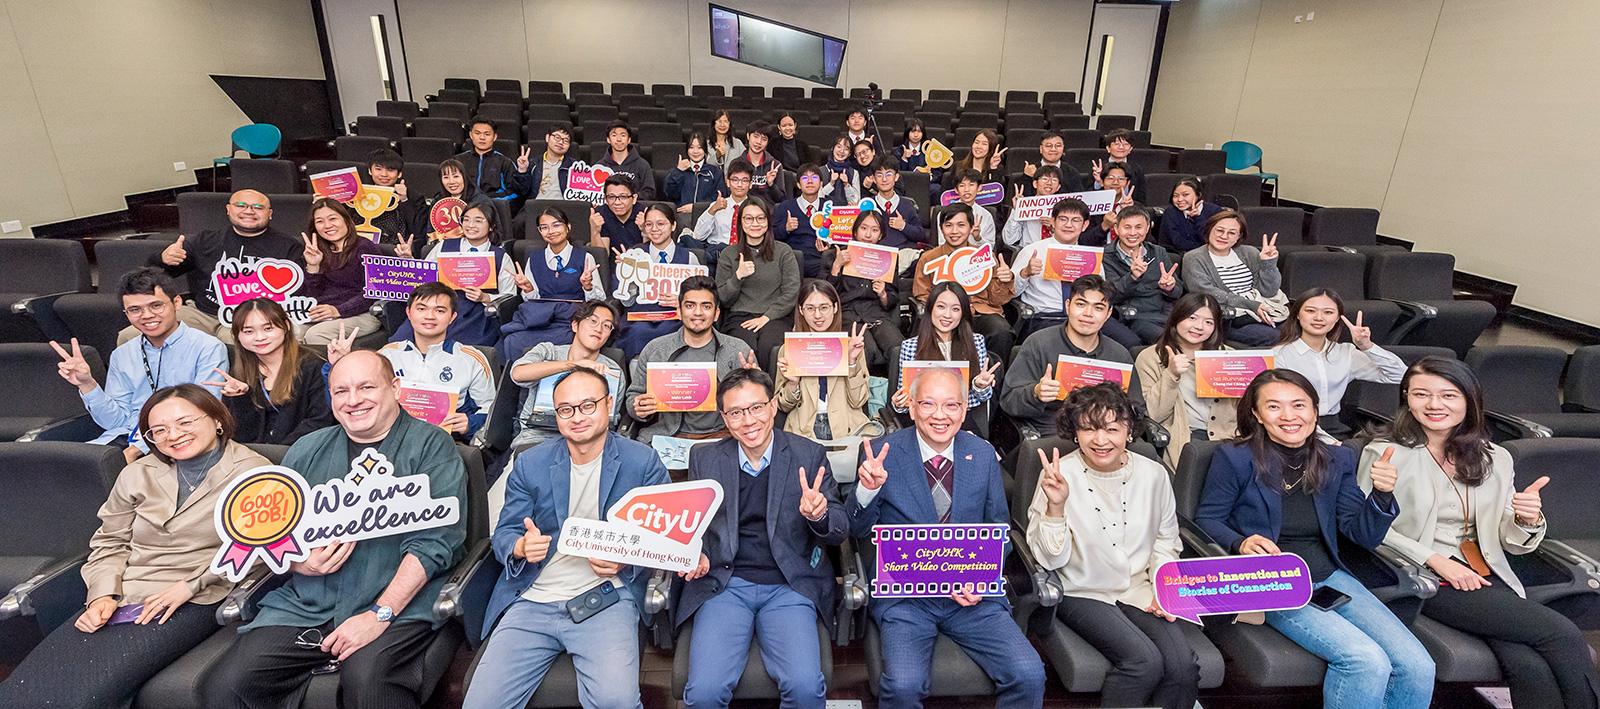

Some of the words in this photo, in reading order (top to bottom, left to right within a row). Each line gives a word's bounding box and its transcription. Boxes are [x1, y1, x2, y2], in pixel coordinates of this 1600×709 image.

[573, 163, 591, 173] We
[572, 175, 590, 184] Love
[566, 189, 606, 204] CityUH
[440, 205, 463, 226] 30
[1019, 208, 1043, 218] INTO
[971, 251, 991, 264] CityU
[221, 261, 254, 280] We
[387, 270, 416, 279] CityUHK
[653, 265, 691, 278] Cheers
[964, 275, 982, 284] YEARS
[223, 282, 262, 297] Love
[646, 278, 672, 300] 30
[240, 491, 285, 513] GOOD
[314, 485, 361, 515] We
[369, 482, 422, 503] are
[242, 499, 289, 529] JOB!
[627, 502, 702, 534] CityU
[303, 504, 451, 543] excellence
[569, 525, 641, 545] 香港城市大學
[565, 538, 584, 551] City
[585, 541, 630, 557] University
[630, 548, 641, 557] of
[642, 550, 667, 563] Hong
[667, 553, 692, 567] Kong
[915, 547, 965, 560] CityUHK
[882, 562, 909, 572] Short
[911, 561, 939, 571] Video
[940, 561, 998, 573] Competition
[1163, 574, 1206, 586] Bridges
[1206, 574, 1218, 582] to
[1218, 569, 1279, 582] Innovation
[1280, 567, 1302, 578] and
[1178, 586, 1217, 597] Stories
[1218, 584, 1231, 594] of
[1230, 581, 1293, 594] Connection
